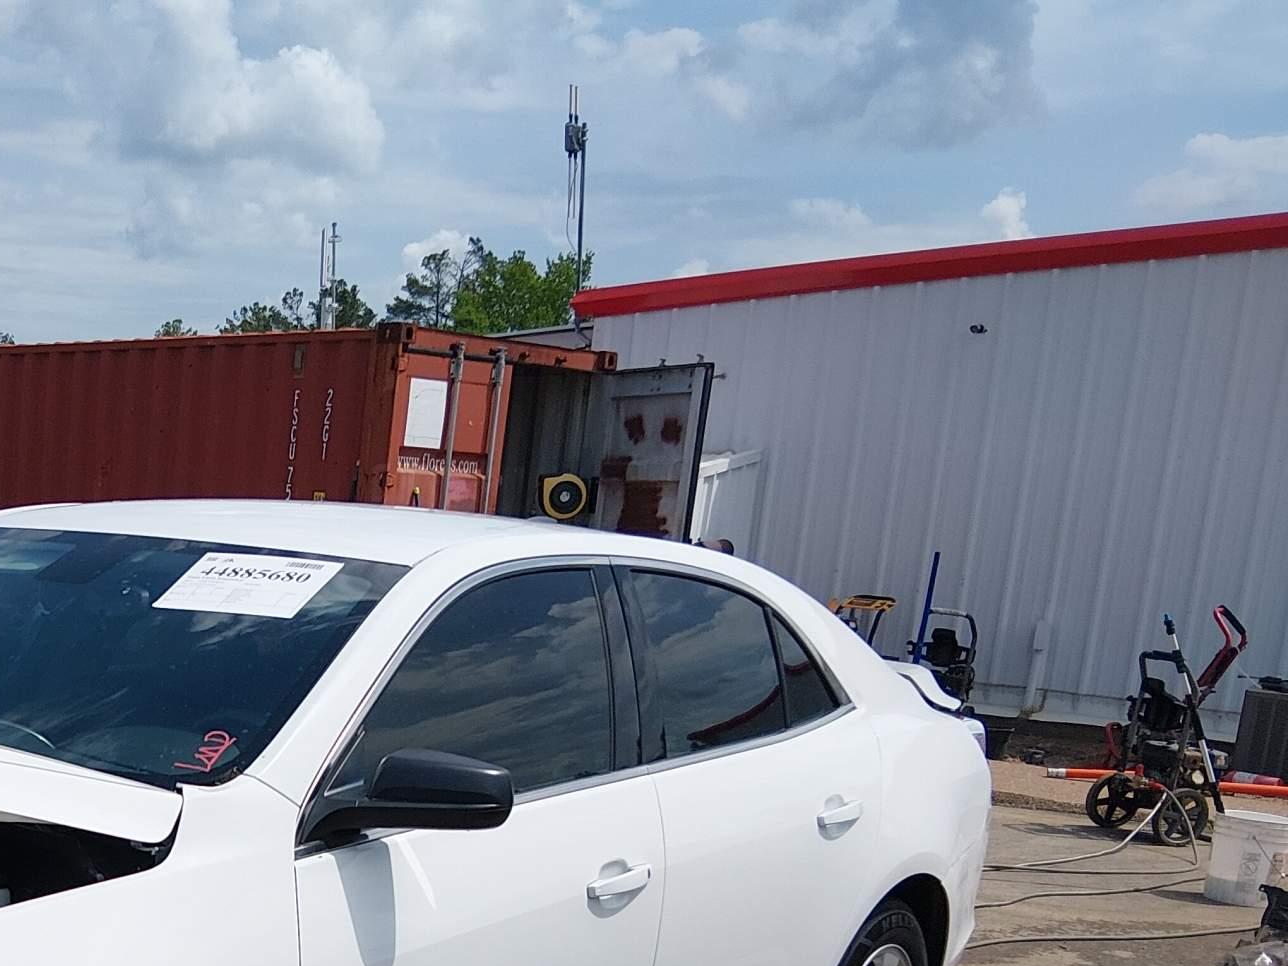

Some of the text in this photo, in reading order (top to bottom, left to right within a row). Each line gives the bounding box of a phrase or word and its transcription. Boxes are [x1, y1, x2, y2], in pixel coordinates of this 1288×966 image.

[289, 389, 300, 460] FSCU
[322, 388, 333, 460] 22G1
[397, 453, 479, 474] www.flores.com
[200, 566, 312, 583] 44885680
